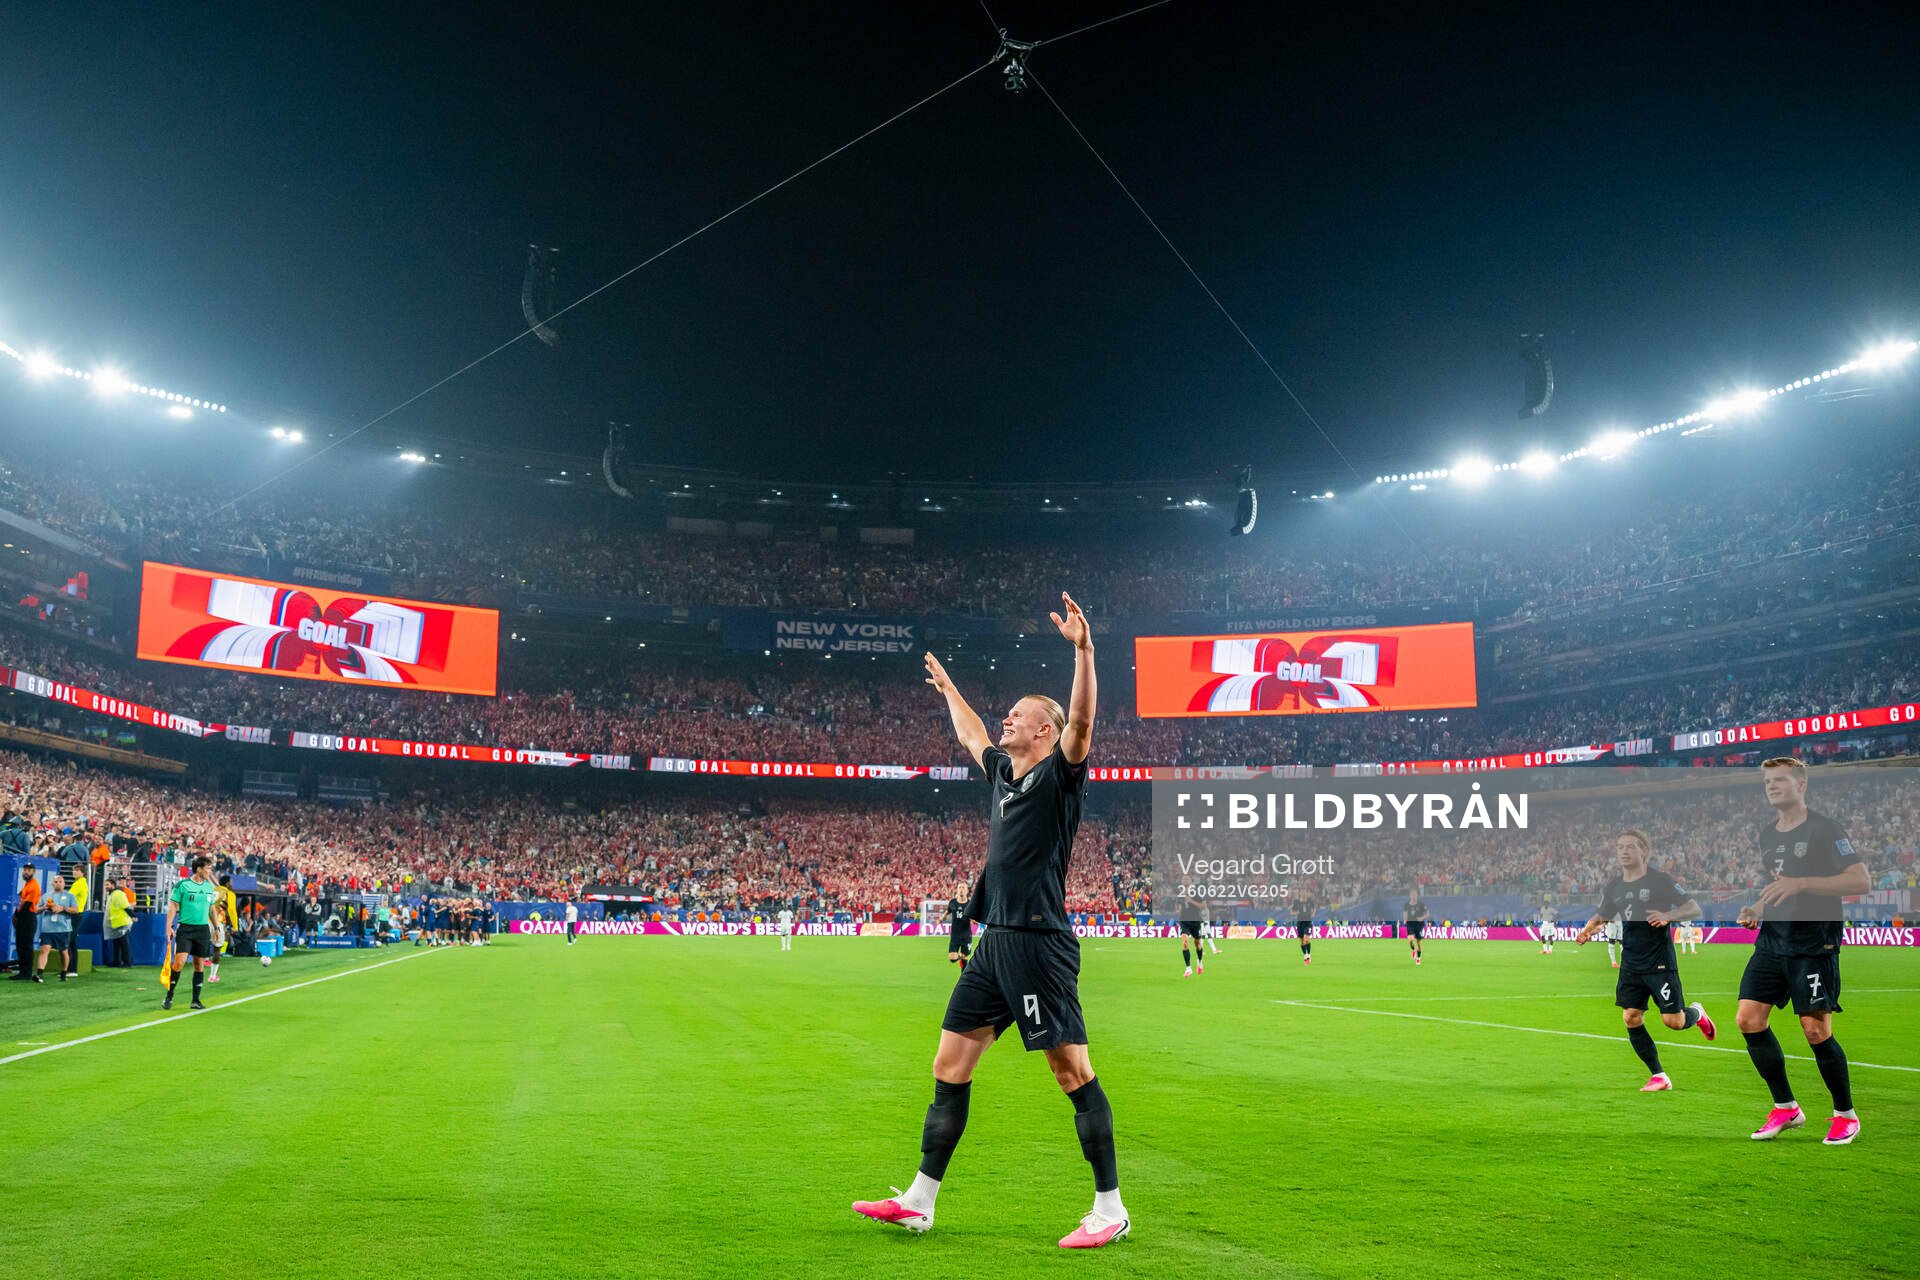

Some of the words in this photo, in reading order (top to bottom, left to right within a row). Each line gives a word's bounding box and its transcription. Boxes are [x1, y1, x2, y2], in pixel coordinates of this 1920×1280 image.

[776, 621, 836, 636] NEW
[838, 624, 913, 639] YORK
[1227, 621, 1254, 631] FIFA
[1255, 618, 1300, 630] WORLD
[1304, 616, 1328, 627] CUP
[1332, 615, 1377, 626] 2026
[298, 617, 349, 650] GOAL
[776, 637, 825, 649] NEW
[829, 640, 914, 653] JERSEY
[1276, 661, 1325, 683] GOAL
[28, 676, 78, 704] GOOOAL
[92, 695, 139, 720] GOOOAL
[1690, 726, 1760, 746] GOOOAL
[1784, 713, 1861, 735] GOOOAL
[309, 734, 380, 752] GOOOAL
[402, 743, 470, 760] GOOOAL
[665, 759, 730, 773] GOOOAL
[751, 763, 814, 776] GOOOAL
[1089, 768, 1152, 780] GOOOAL
[1351, 763, 1419, 776] GOOOAL
[1443, 757, 1506, 773] GOOOAL
[1775, 858, 1784, 875] 7
[1624, 903, 1633, 921] 6
[579, 921, 644, 935] AIRWAYS
[681, 922, 751, 936] WORLD'S
[797, 923, 857, 936] AIRLINE
[1129, 925, 1164, 938] BEST
[1275, 926, 1321, 939] QAR
[1326, 925, 1383, 938] AIRWAYS
[1450, 926, 1488, 939] AIRWAYS
[1842, 928, 1914, 945] AIRWAYS
[1660, 982, 1670, 1000] 6
[1806, 973, 1821, 997] 7
[1023, 994, 1041, 1025] 9
